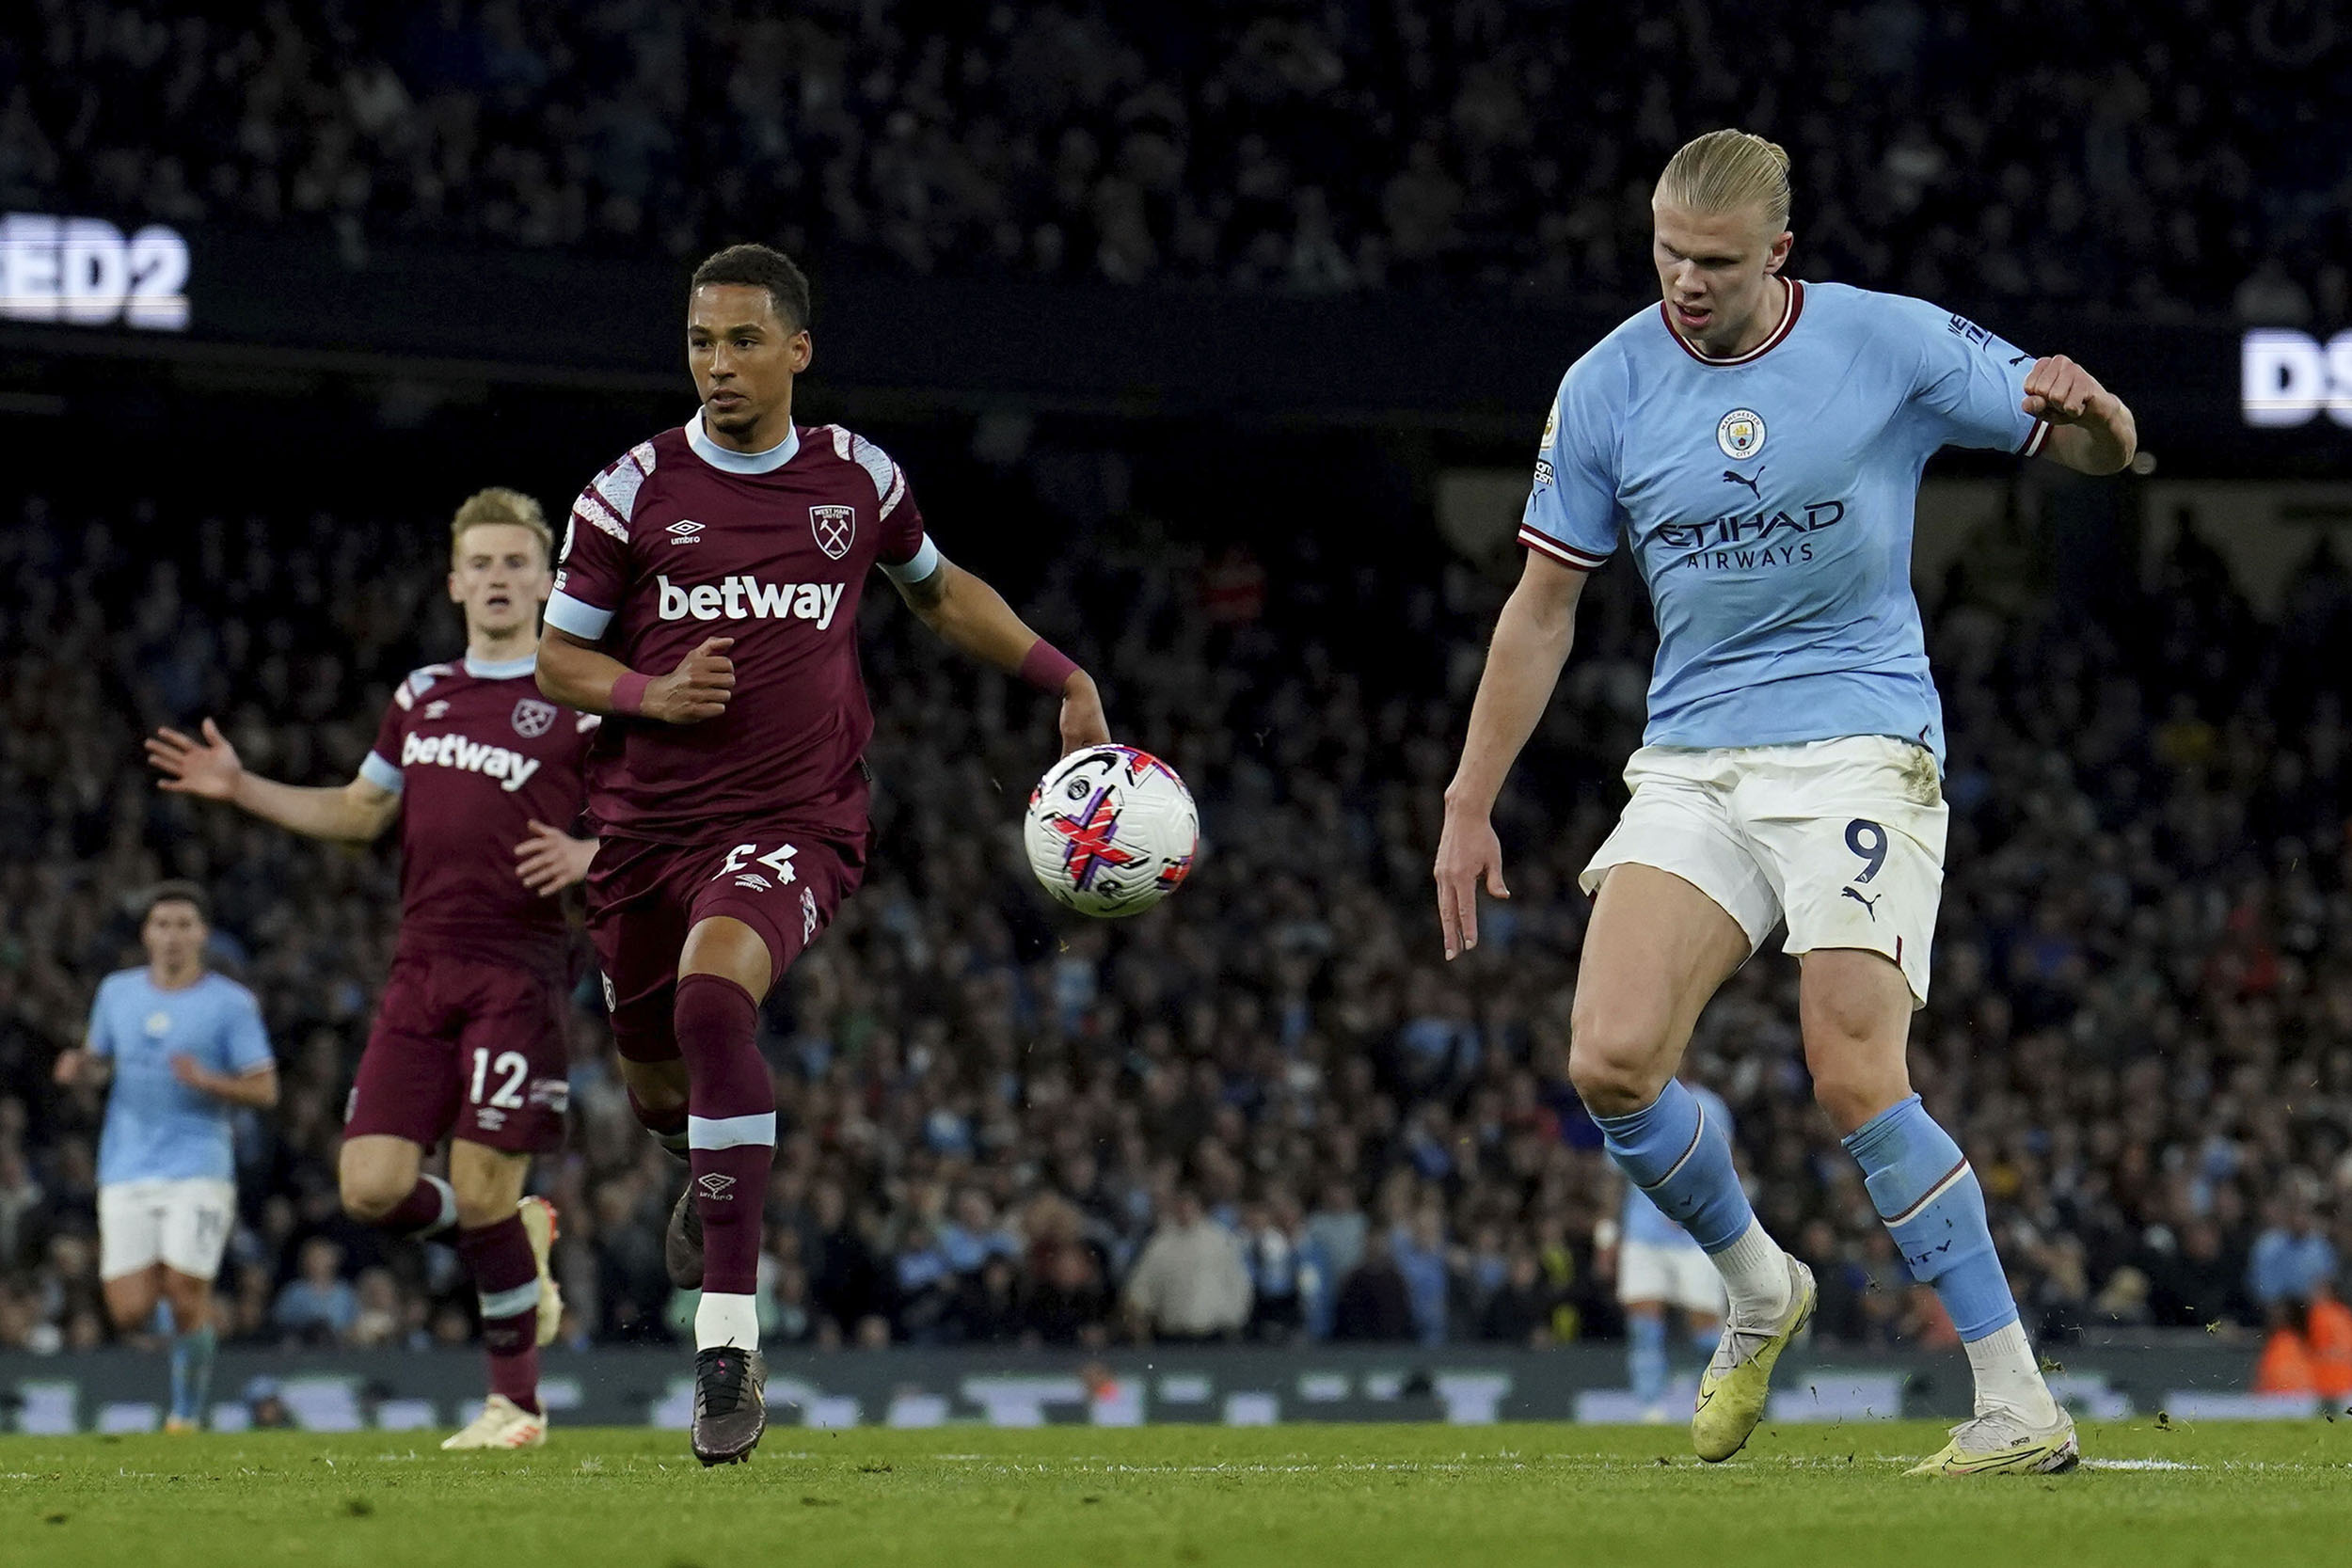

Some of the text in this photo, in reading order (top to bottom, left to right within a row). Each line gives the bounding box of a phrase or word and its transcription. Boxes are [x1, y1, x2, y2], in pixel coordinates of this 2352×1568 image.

[0, 212, 191, 331] ED2
[1722, 412, 1760, 430] MANCHESTER
[671, 535, 701, 546] umbro
[1658, 500, 1844, 547] ETIHAD
[1687, 543, 1814, 569] AIRWAYS
[656, 575, 846, 630] betway
[402, 731, 542, 792] betway
[1844, 818, 1887, 883] 9
[735, 880, 764, 893] umbro
[469, 1047, 529, 1110] 12
